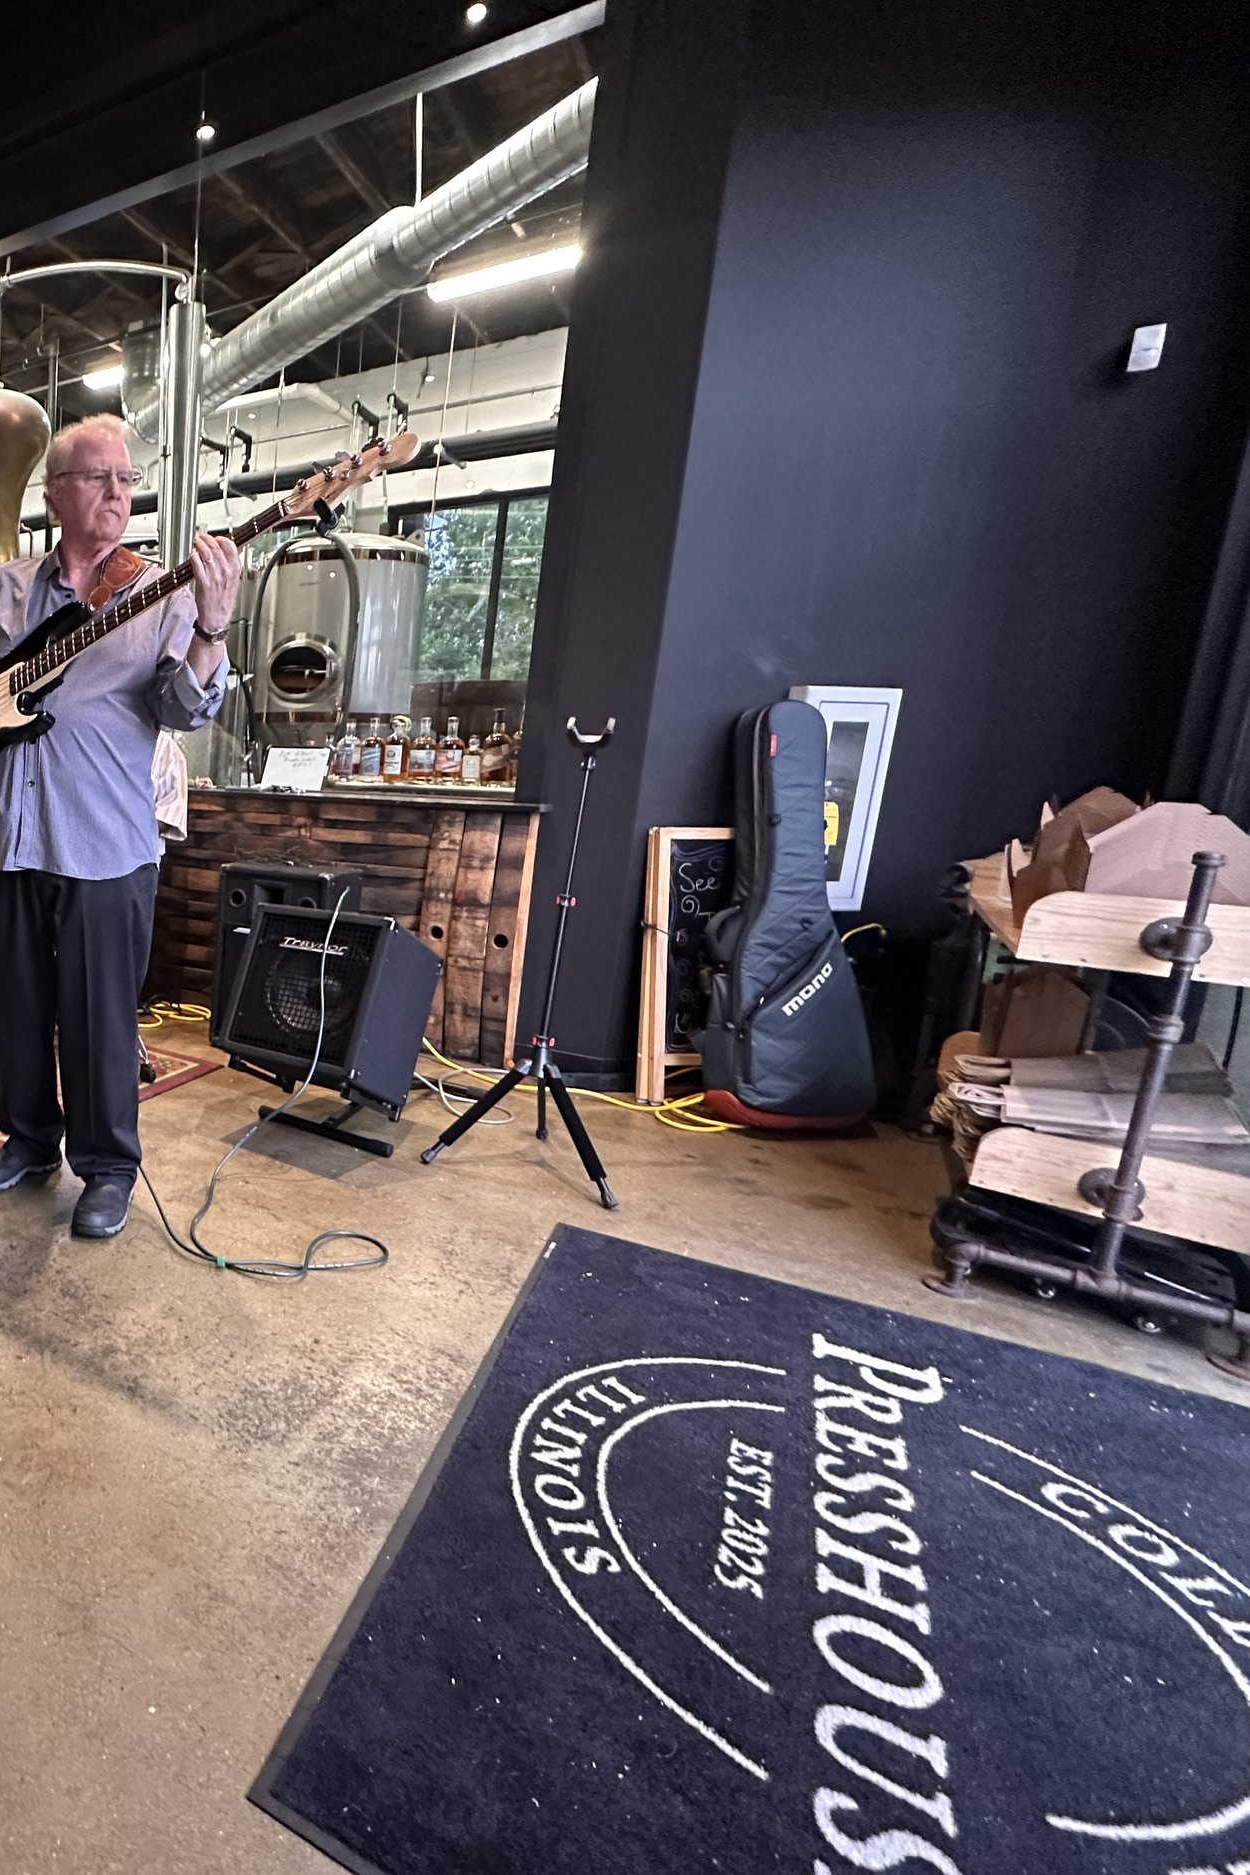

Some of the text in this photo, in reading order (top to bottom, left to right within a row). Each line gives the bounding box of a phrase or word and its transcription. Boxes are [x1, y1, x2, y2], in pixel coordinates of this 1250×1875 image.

[678, 862, 721, 893] See
[782, 961, 833, 1016] mono
[530, 1376, 646, 1575] ILLINOIS
[714, 1438, 774, 1600] EST. 2025
[812, 1333, 963, 1875] PRESSHOUS
